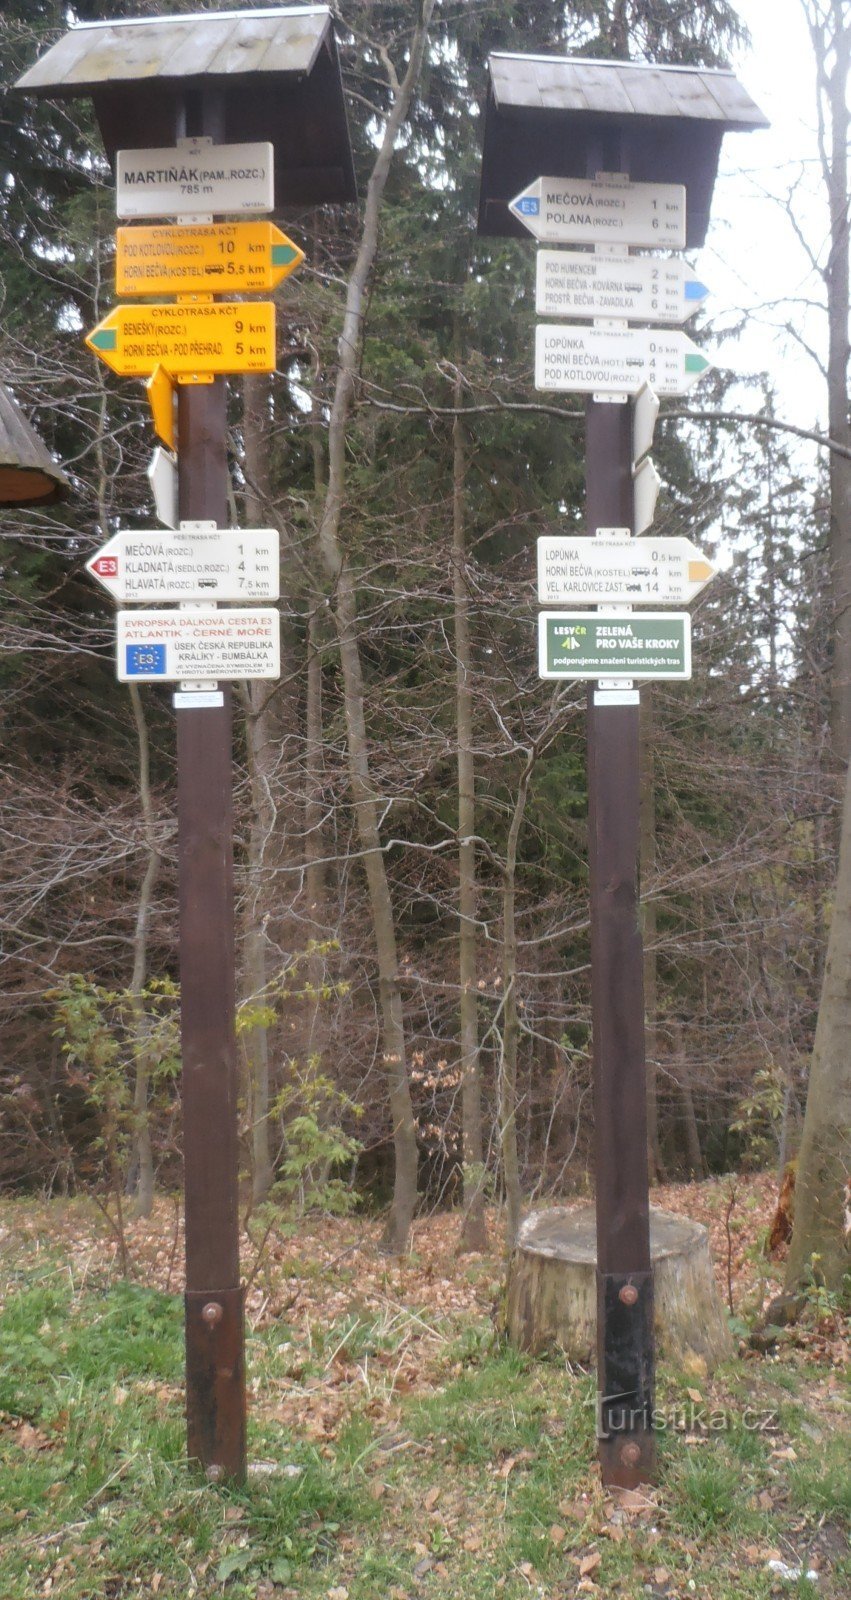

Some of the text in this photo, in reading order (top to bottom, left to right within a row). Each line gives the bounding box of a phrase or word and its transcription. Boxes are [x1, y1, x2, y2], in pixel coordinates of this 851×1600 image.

[124, 167, 199, 184] MARTIŇÁK
[180, 185, 199, 194] 785
[521, 202, 538, 213] E3
[547, 192, 679, 211] MEČOVÁ (ROZC.) 1 km
[546, 213, 592, 226] POLANA
[652, 218, 659, 229] 6
[665, 222, 679, 230] km
[152, 227, 238, 238] CYKLOTRASA KČT
[123, 245, 138, 257] POD
[218, 241, 235, 254] 10
[248, 243, 265, 253] km
[123, 264, 145, 278] HORNÍ
[146, 263, 167, 278] BEČVA
[168, 266, 204, 279] (KOSTEL)
[248, 265, 265, 274] km
[546, 262, 679, 281] POD HUMENCEM 2 km
[545, 277, 566, 289] HORNÍ
[567, 277, 588, 291] BEČVA
[593, 280, 624, 293] KOVÁRNA
[652, 284, 658, 295] 5
[665, 288, 679, 296] km
[573, 293, 595, 306] BEČVA
[600, 296, 634, 309] ZAVADILKA
[651, 299, 658, 309] 6
[665, 303, 678, 311] km
[152, 306, 238, 317] CYKLOTRASA KČT
[123, 320, 266, 337] BENEŠKY (ROZC.) 9 km
[123, 343, 145, 357] HORNÍ
[146, 341, 169, 357] BEČVA
[174, 344, 188, 356] POD
[235, 343, 244, 355] 5
[249, 345, 266, 355] km
[545, 337, 584, 349] LOPŮNKA
[545, 353, 571, 365] HORNÍ
[573, 352, 600, 366] BEČVA
[650, 358, 656, 367] 4
[665, 361, 678, 369] km
[545, 369, 561, 380] POD
[564, 370, 610, 382] KOTLOVOU
[649, 374, 656, 383] 8
[125, 542, 269, 557] MEČOVÁ (ROZC.) 1 km
[546, 549, 579, 560] LOPŮNKA
[668, 554, 681, 562] km
[99, 561, 117, 573] E3
[238, 562, 246, 572] 4
[256, 564, 269, 572] km
[546, 563, 567, 576] HORNÍ
[570, 563, 592, 576] BEČVA
[594, 569, 630, 578] (KOSTEL)
[652, 567, 659, 576] 4
[125, 576, 270, 591] HLAVATÁ (ROZC.) 7,5 km
[546, 582, 562, 592] VEL.
[564, 582, 602, 592] KARLOVICE
[646, 582, 659, 592] 14
[669, 584, 682, 592] km
[125, 619, 177, 628] EVROPSKÁ
[179, 618, 225, 627] DÁLKOVÁ
[228, 618, 258, 626] CESTA
[125, 630, 182, 638] ATLANTIK
[193, 628, 234, 637] ČERNÉ
[237, 628, 272, 636] MOŘE
[596, 625, 633, 636] ZELENÁ
[174, 640, 274, 651] ÚSEK ČESKÁ REPUBLIKA
[596, 637, 680, 649] PRO VAŠE KROKY
[222, 650, 269, 660] BUMBÁLKA
[553, 657, 599, 667] podporujeme
[600, 657, 626, 665] značení
[626, 657, 666, 667] turistických
